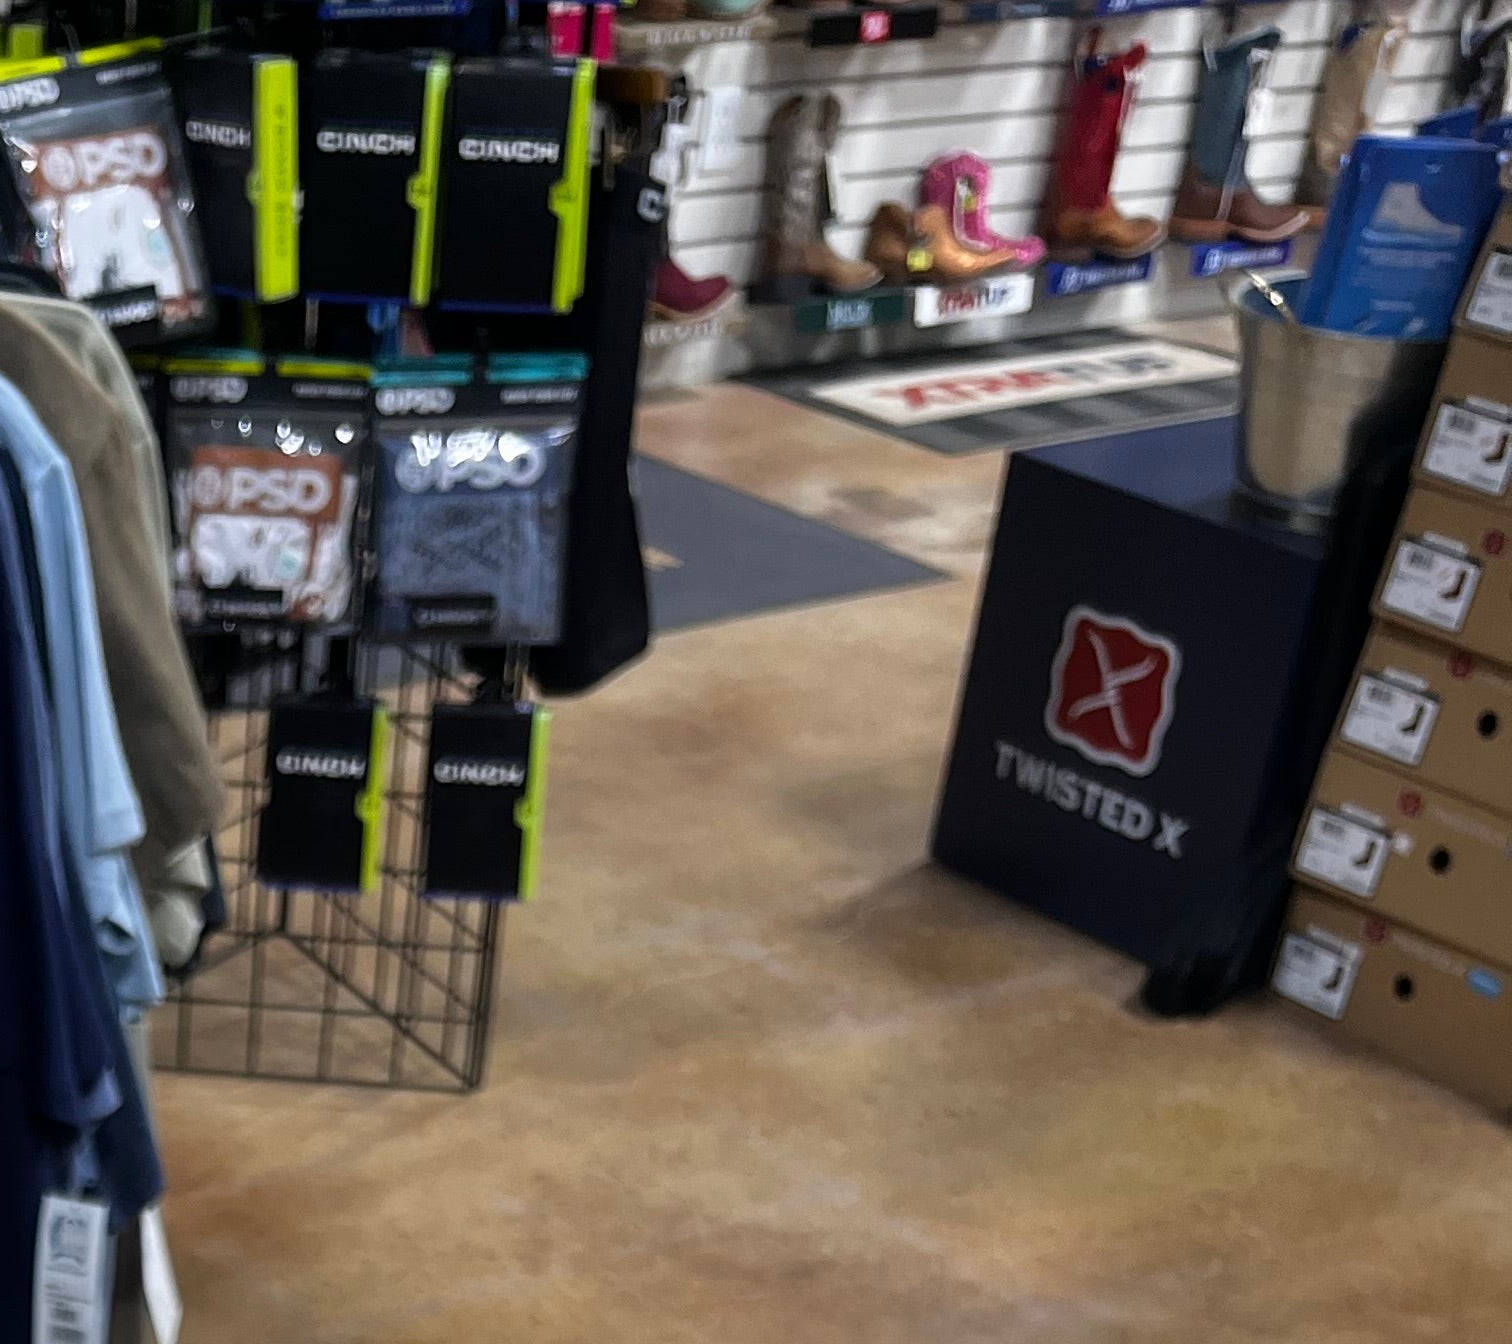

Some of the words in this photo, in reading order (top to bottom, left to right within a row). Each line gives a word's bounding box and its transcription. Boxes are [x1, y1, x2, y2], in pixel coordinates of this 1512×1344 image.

[317, 129, 416, 156] CINCH
[459, 138, 560, 164] CINCH
[225, 466, 331, 514] PSD
[275, 750, 367, 779] CINCH
[433, 758, 525, 787] CINCH
[995, 738, 1152, 842] TWISTED
[1151, 811, 1190, 860] X
